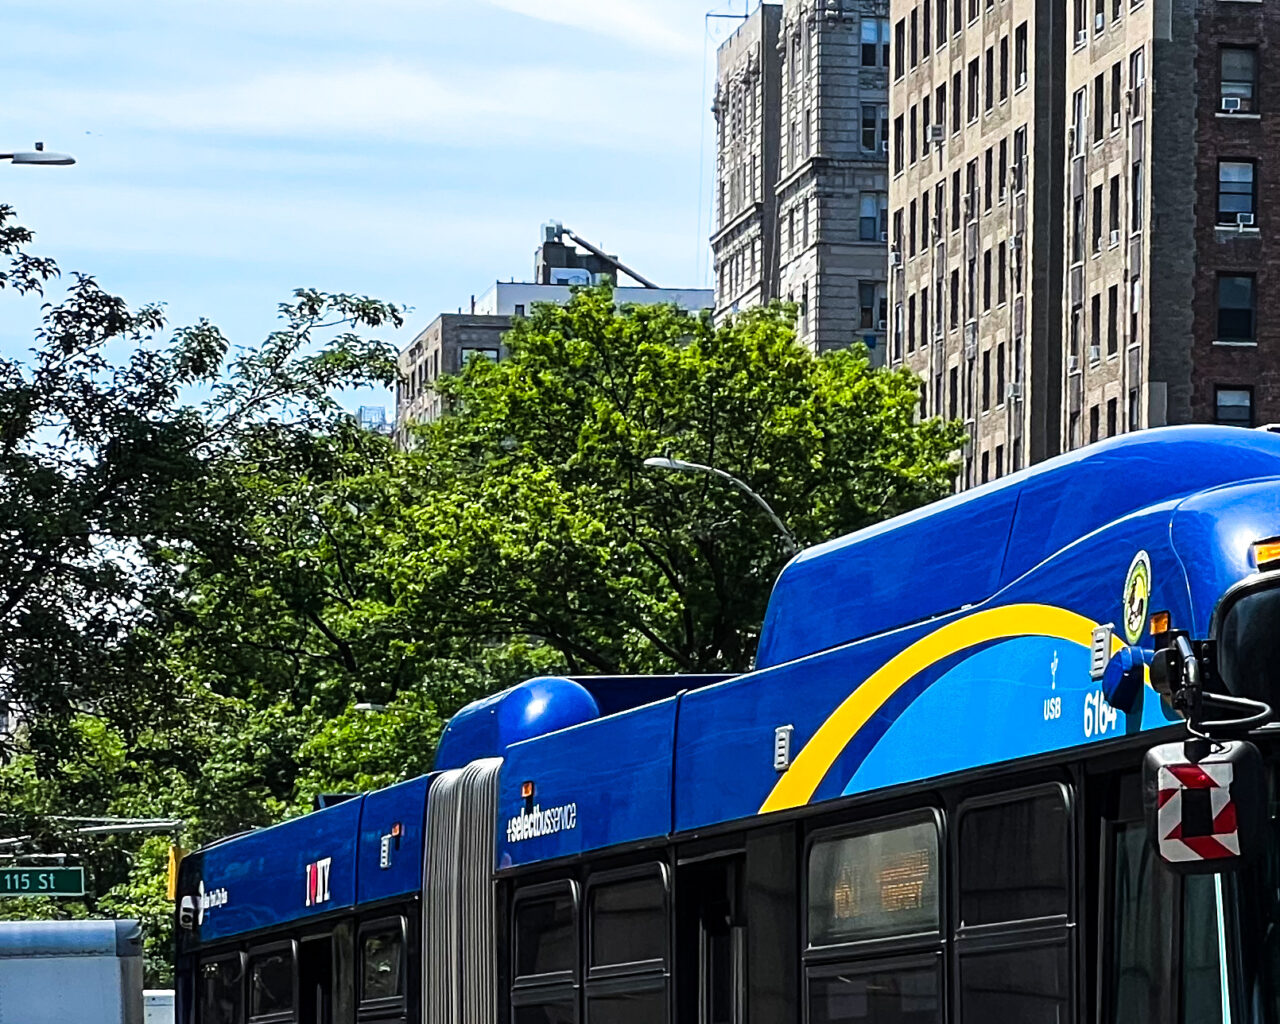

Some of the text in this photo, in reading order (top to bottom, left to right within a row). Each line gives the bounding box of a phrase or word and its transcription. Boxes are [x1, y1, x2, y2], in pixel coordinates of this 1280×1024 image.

[1043, 696, 1062, 721] USB
[4, 872, 56, 890] 115 St
